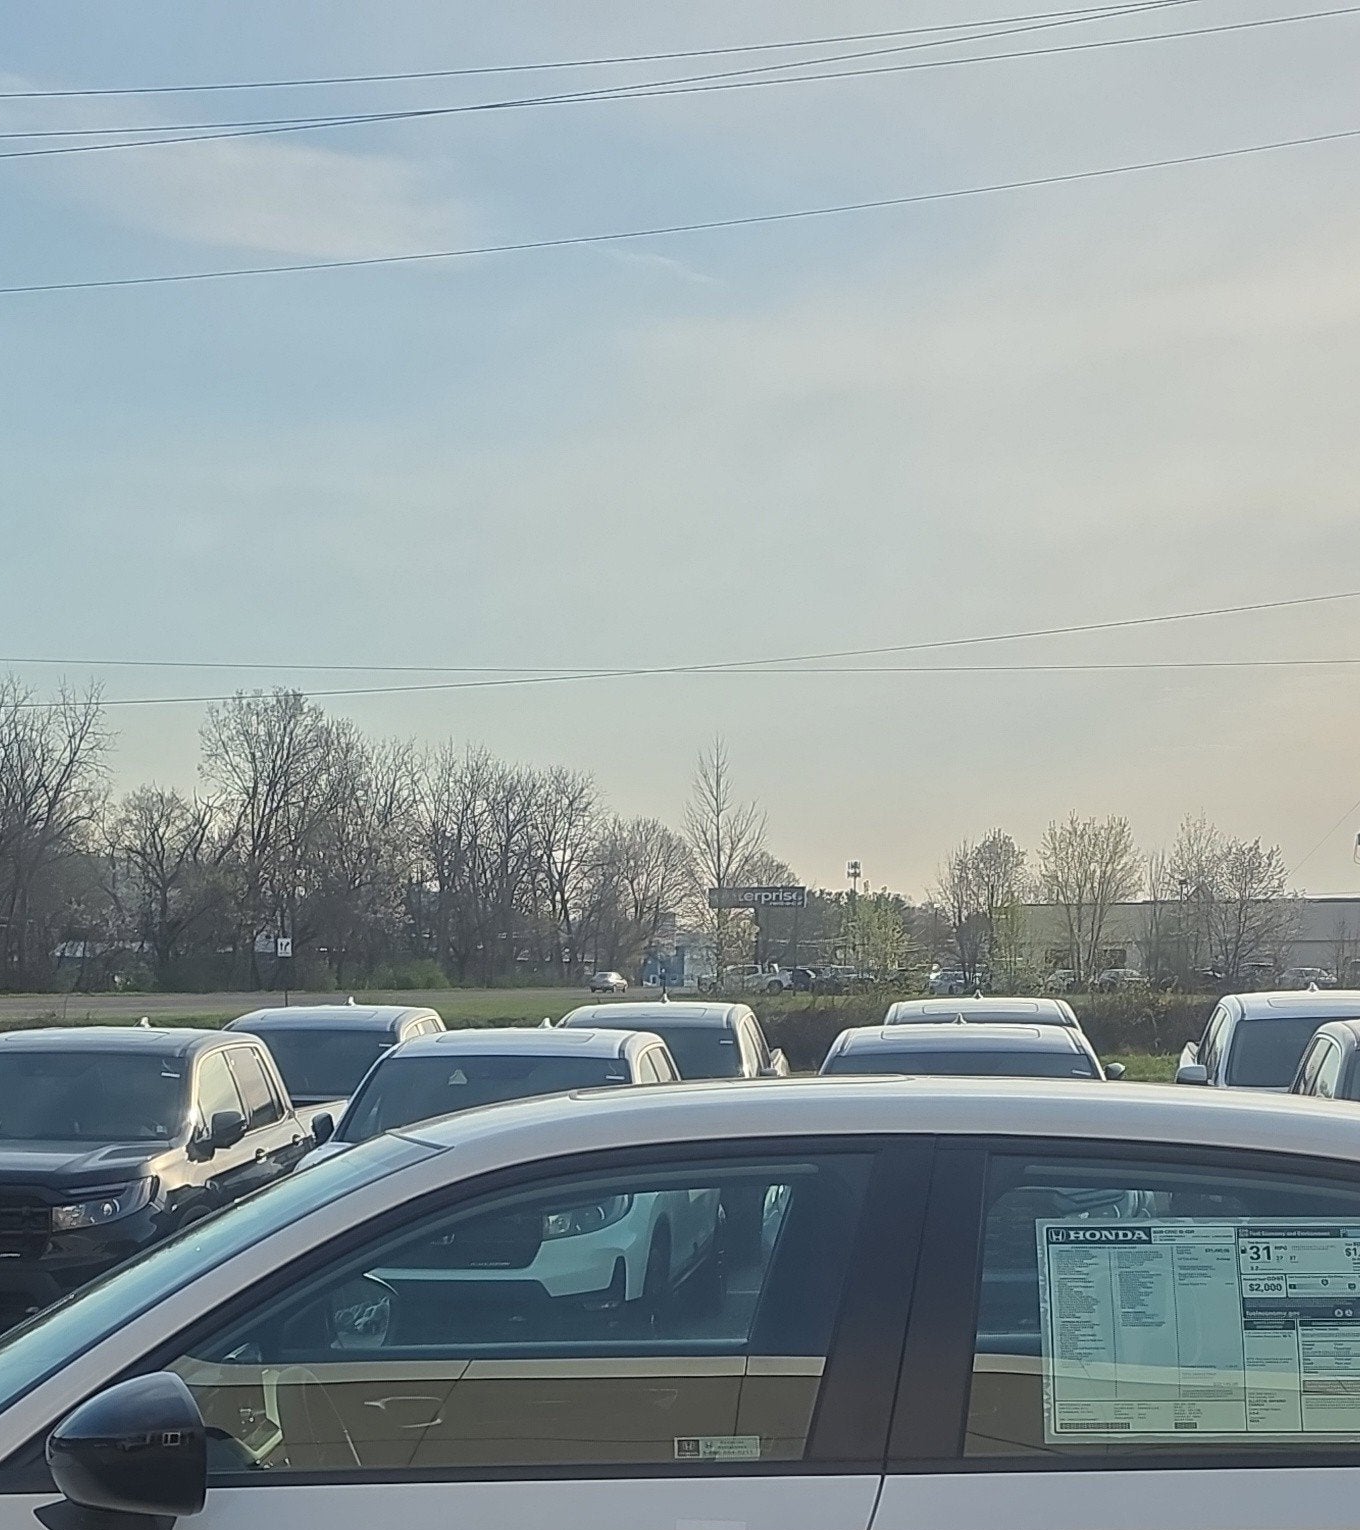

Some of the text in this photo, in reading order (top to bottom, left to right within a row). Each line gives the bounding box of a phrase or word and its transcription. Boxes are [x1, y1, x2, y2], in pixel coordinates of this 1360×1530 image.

[1068, 1230, 1150, 1241] HONDA
[1249, 1245, 1271, 1261] 31
[1248, 1283, 1283, 1292] $2,000
